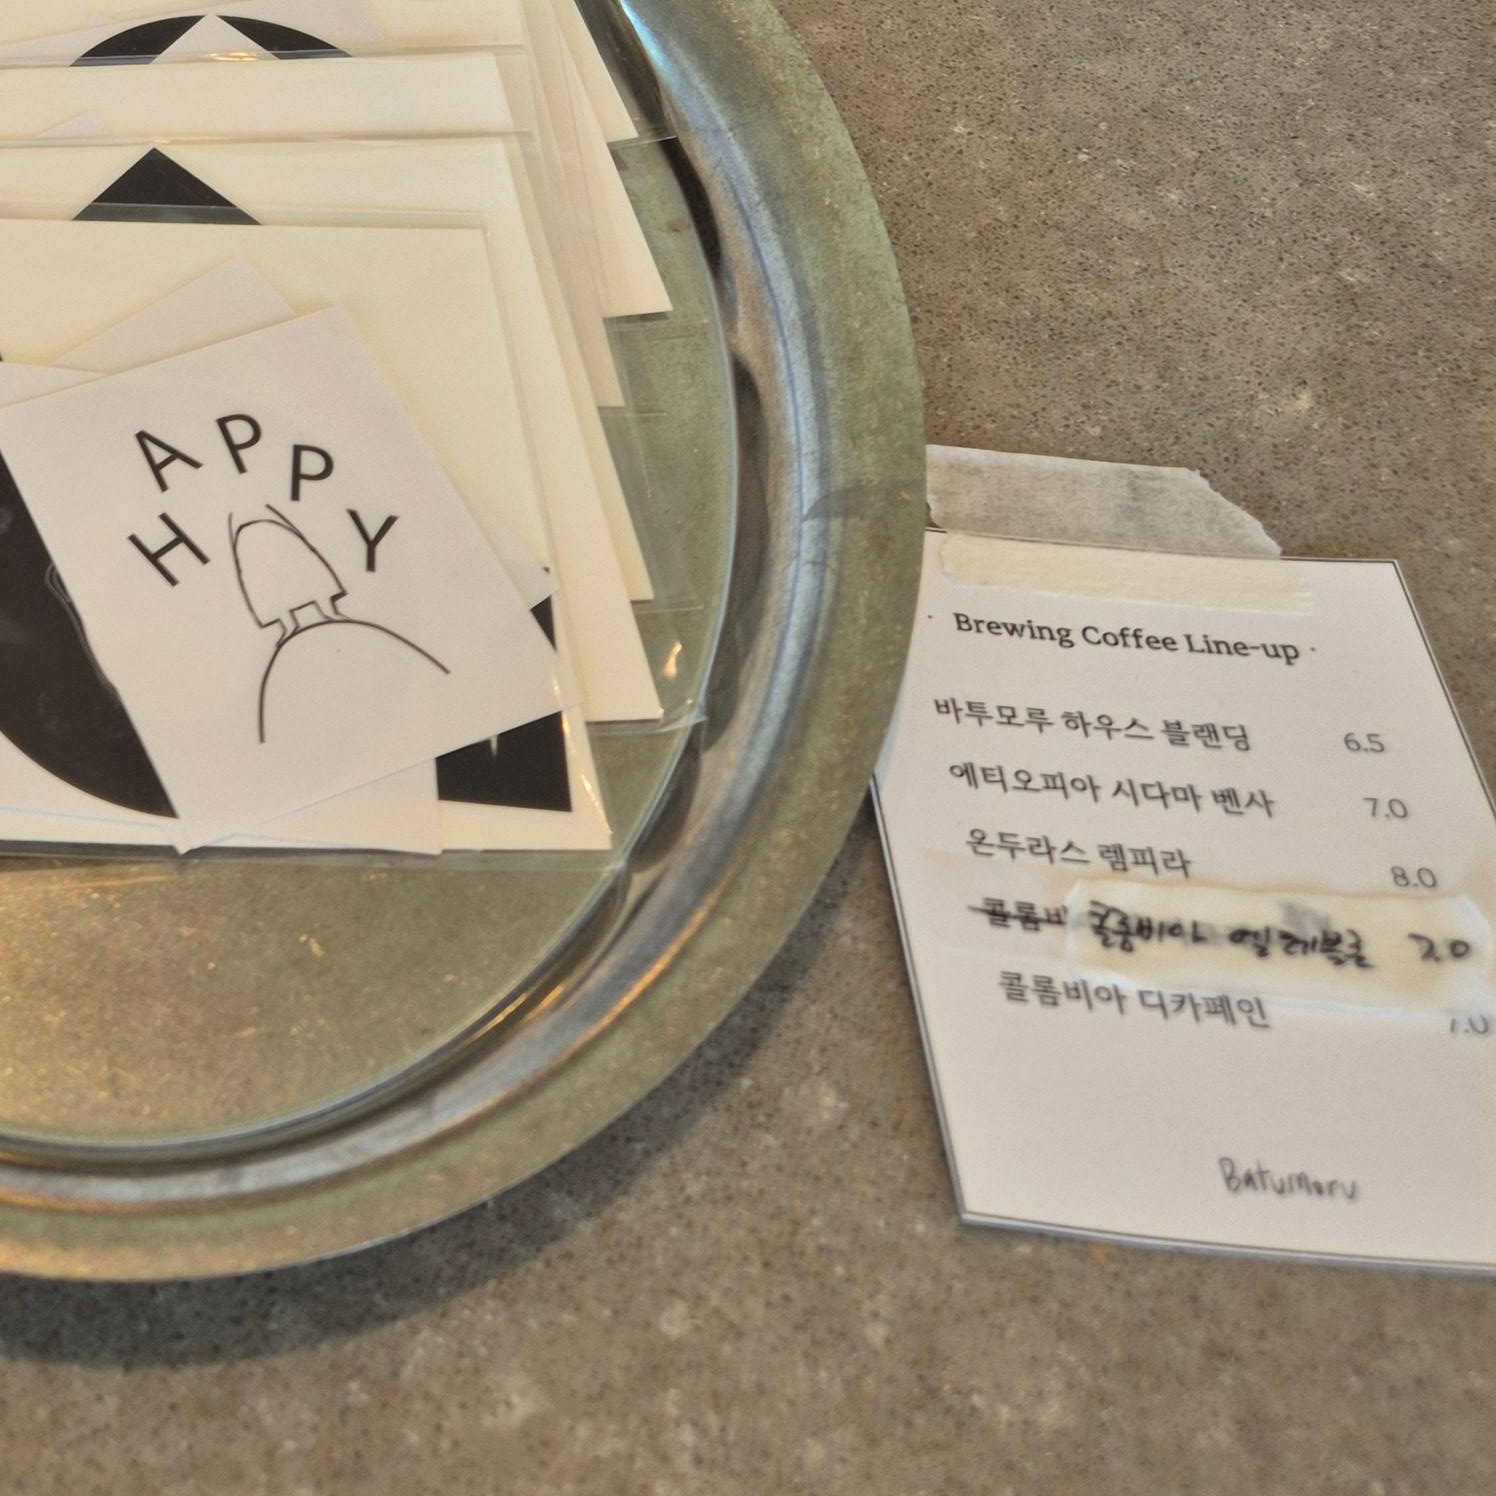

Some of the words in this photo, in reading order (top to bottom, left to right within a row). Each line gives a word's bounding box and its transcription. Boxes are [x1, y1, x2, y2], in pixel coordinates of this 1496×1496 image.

[952, 612, 1075, 649] Brewing
[1081, 625, 1179, 653] Coffee
[1185, 634, 1301, 666] Line-up
[933, 697, 1055, 735] 바투모루
[1060, 709, 1154, 741] 하우스
[1160, 718, 1252, 753] 블랜딩
[1343, 732, 1385, 753] 6.5
[949, 761, 1102, 805] 에티오피아
[1111, 778, 1203, 813] 시다마
[1210, 786, 1276, 819] 벤사
[1362, 797, 1408, 819] 7.0
[965, 827, 1091, 865] 온두라스
[1098, 842, 1194, 879] 렘피라
[1390, 865, 1437, 888] 8.0
[998, 970, 1129, 1016] 콜롬비아
[1136, 988, 1271, 1029] 디카페인
